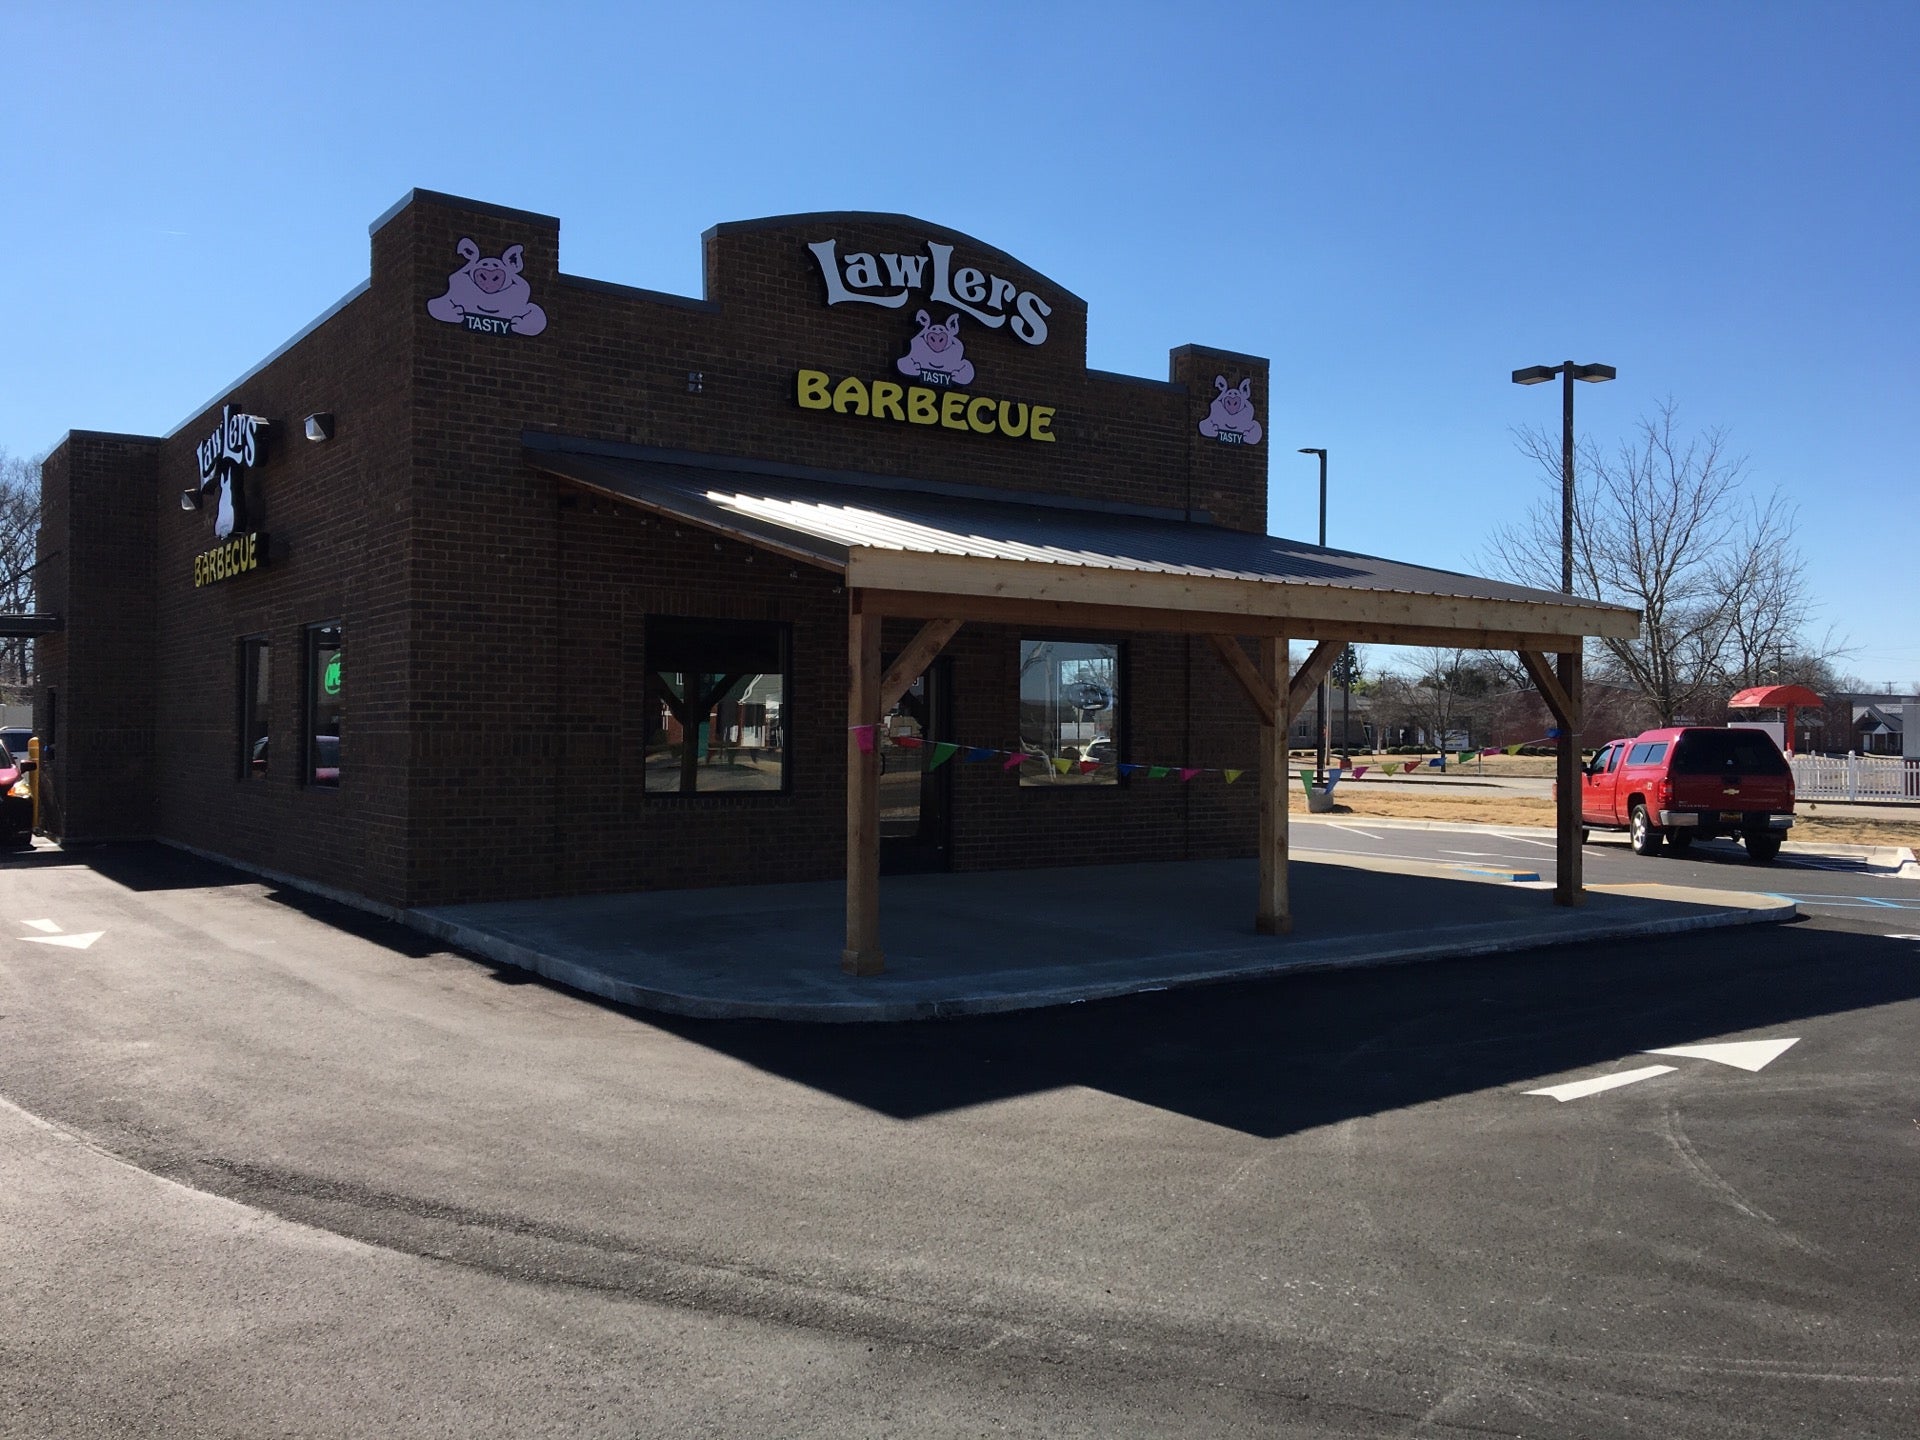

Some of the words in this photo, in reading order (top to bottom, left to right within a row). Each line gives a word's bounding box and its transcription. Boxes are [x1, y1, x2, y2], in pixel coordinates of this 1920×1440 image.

[465, 315, 510, 334] TASTY
[921, 370, 951, 385] TASTY
[797, 369, 1056, 442] BARBECUE
[1218, 431, 1243, 444] TASTY
[194, 532, 257, 588] BARBECUE
